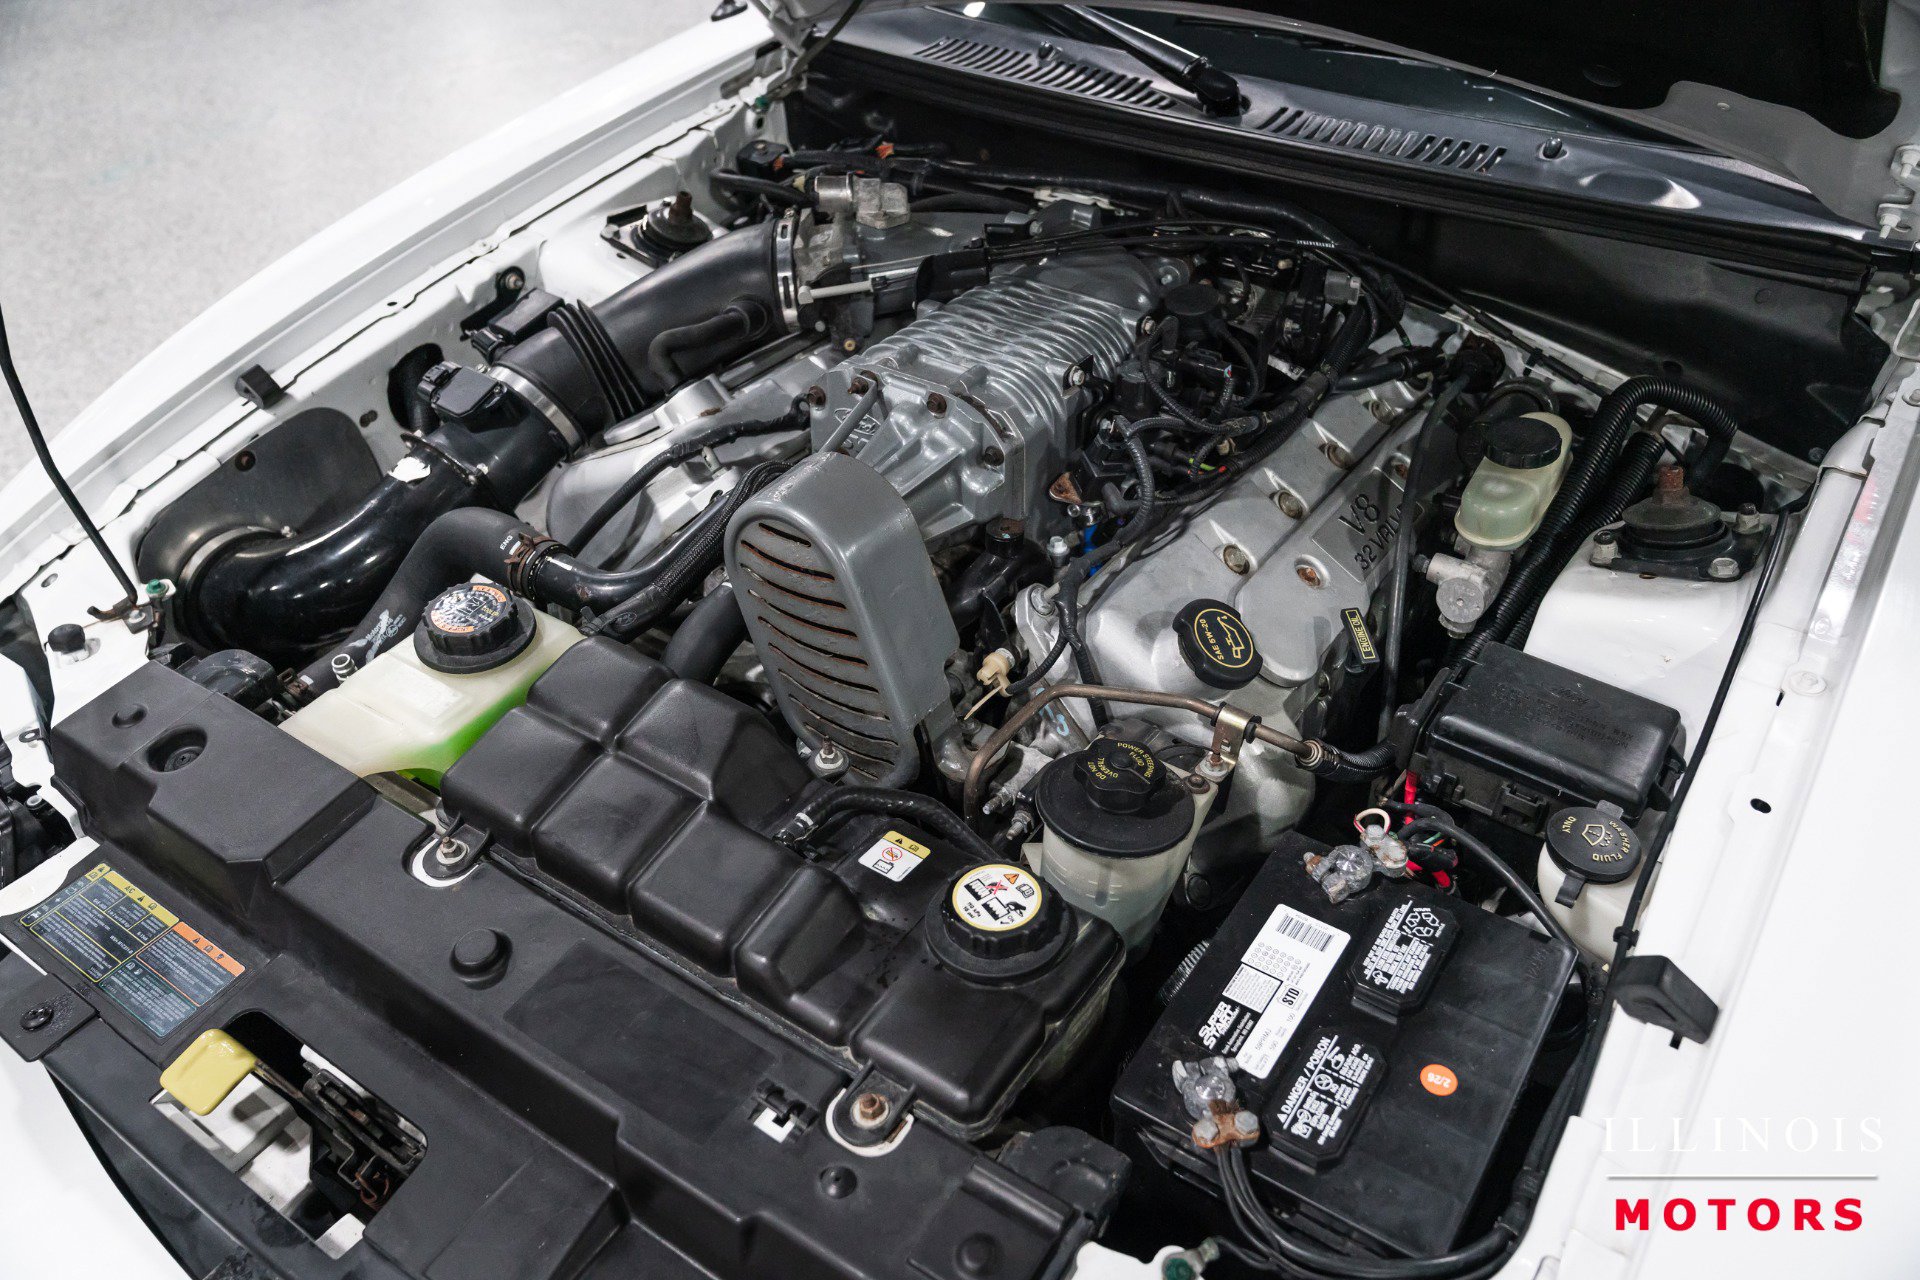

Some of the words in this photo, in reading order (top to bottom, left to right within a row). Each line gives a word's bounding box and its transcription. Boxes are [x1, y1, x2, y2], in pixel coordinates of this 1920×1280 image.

[1338, 493, 1380, 536] V8
[500, 535, 513, 550] ENG
[1354, 545, 1377, 571] 32
[1369, 502, 1403, 550] VALV
[1350, 615, 1360, 627] OIL
[1353, 625, 1371, 652] ENGINE
[1212, 644, 1224, 660] SAE
[1117, 742, 1144, 755] POWER
[1129, 751, 1145, 767] FLUID
[1562, 816, 1577, 834] ONLY
[1609, 820, 1631, 854] WASHER
[1592, 853, 1623, 862] FLUID
[1282, 988, 1300, 1006] STD
[1199, 1001, 1228, 1038] SUPER
[1203, 1004, 1231, 1050] START
[1281, 1075, 1309, 1114] DANGER
[1306, 1036, 1331, 1070] POISON
